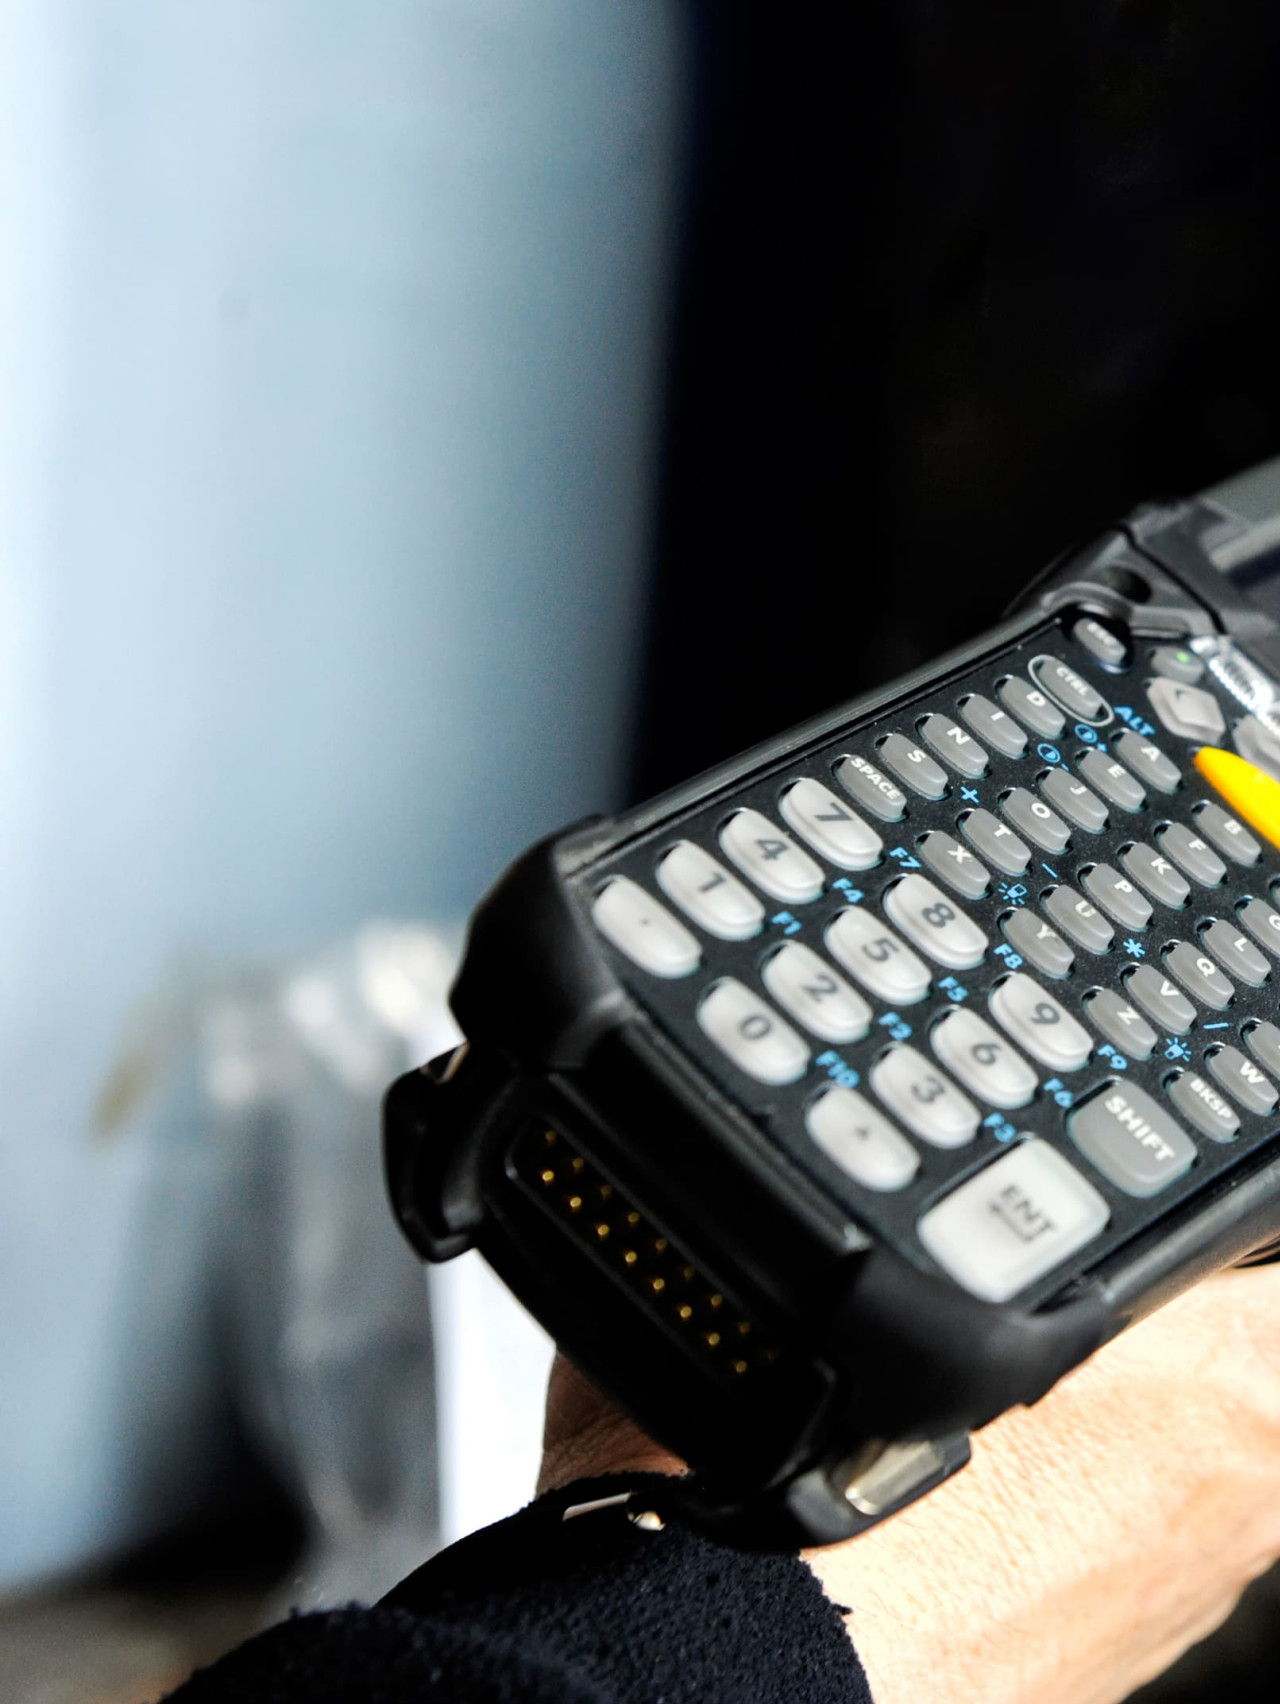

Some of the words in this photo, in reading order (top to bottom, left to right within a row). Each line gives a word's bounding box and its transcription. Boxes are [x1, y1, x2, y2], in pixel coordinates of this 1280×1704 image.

[1056, 667, 1088, 696] CTRL
[1026, 691, 1046, 706] D
[1114, 706, 1155, 737] ALT
[947, 727, 970, 745] N
[907, 750, 925, 764] S
[1141, 747, 1160, 761] A
[851, 758, 901, 801] SPACE
[1107, 764, 1126, 778] E
[1070, 785, 1087, 796] J
[814, 802, 852, 823] 7
[993, 825, 1012, 838] T
[1224, 819, 1242, 834] B
[753, 838, 789, 860] 4
[948, 846, 972, 863] X
[1188, 839, 1206, 851] F
[889, 847, 922, 869] F7
[1150, 858, 1172, 875] K
[698, 874, 726, 894] 1
[832, 878, 865, 903] F4
[1114, 880, 1132, 893] P
[922, 902, 956, 928] 8
[1075, 900, 1097, 918] U
[771, 911, 802, 935] F1
[1036, 924, 1056, 940] Y
[861, 938, 899, 962] 5
[1234, 937, 1248, 952] L
[993, 943, 1023, 970] F8
[1196, 958, 1216, 977] Q
[803, 974, 838, 1002] 2
[938, 977, 970, 1002] F5
[1160, 981, 1179, 996] V
[1031, 1003, 1060, 1025] 9
[1117, 1007, 1140, 1025] Z
[739, 1015, 771, 1040] 0
[971, 1043, 1000, 1066] 6
[1097, 1044, 1128, 1070] F9
[815, 1051, 860, 1088] F10
[1240, 1061, 1266, 1084] W
[910, 1074, 945, 1103] 3
[1043, 1077, 1074, 1108] F6
[1189, 1079, 1232, 1119] BKSP
[1104, 1095, 1176, 1161] SHIFT
[1001, 1184, 1055, 1237] ENT
